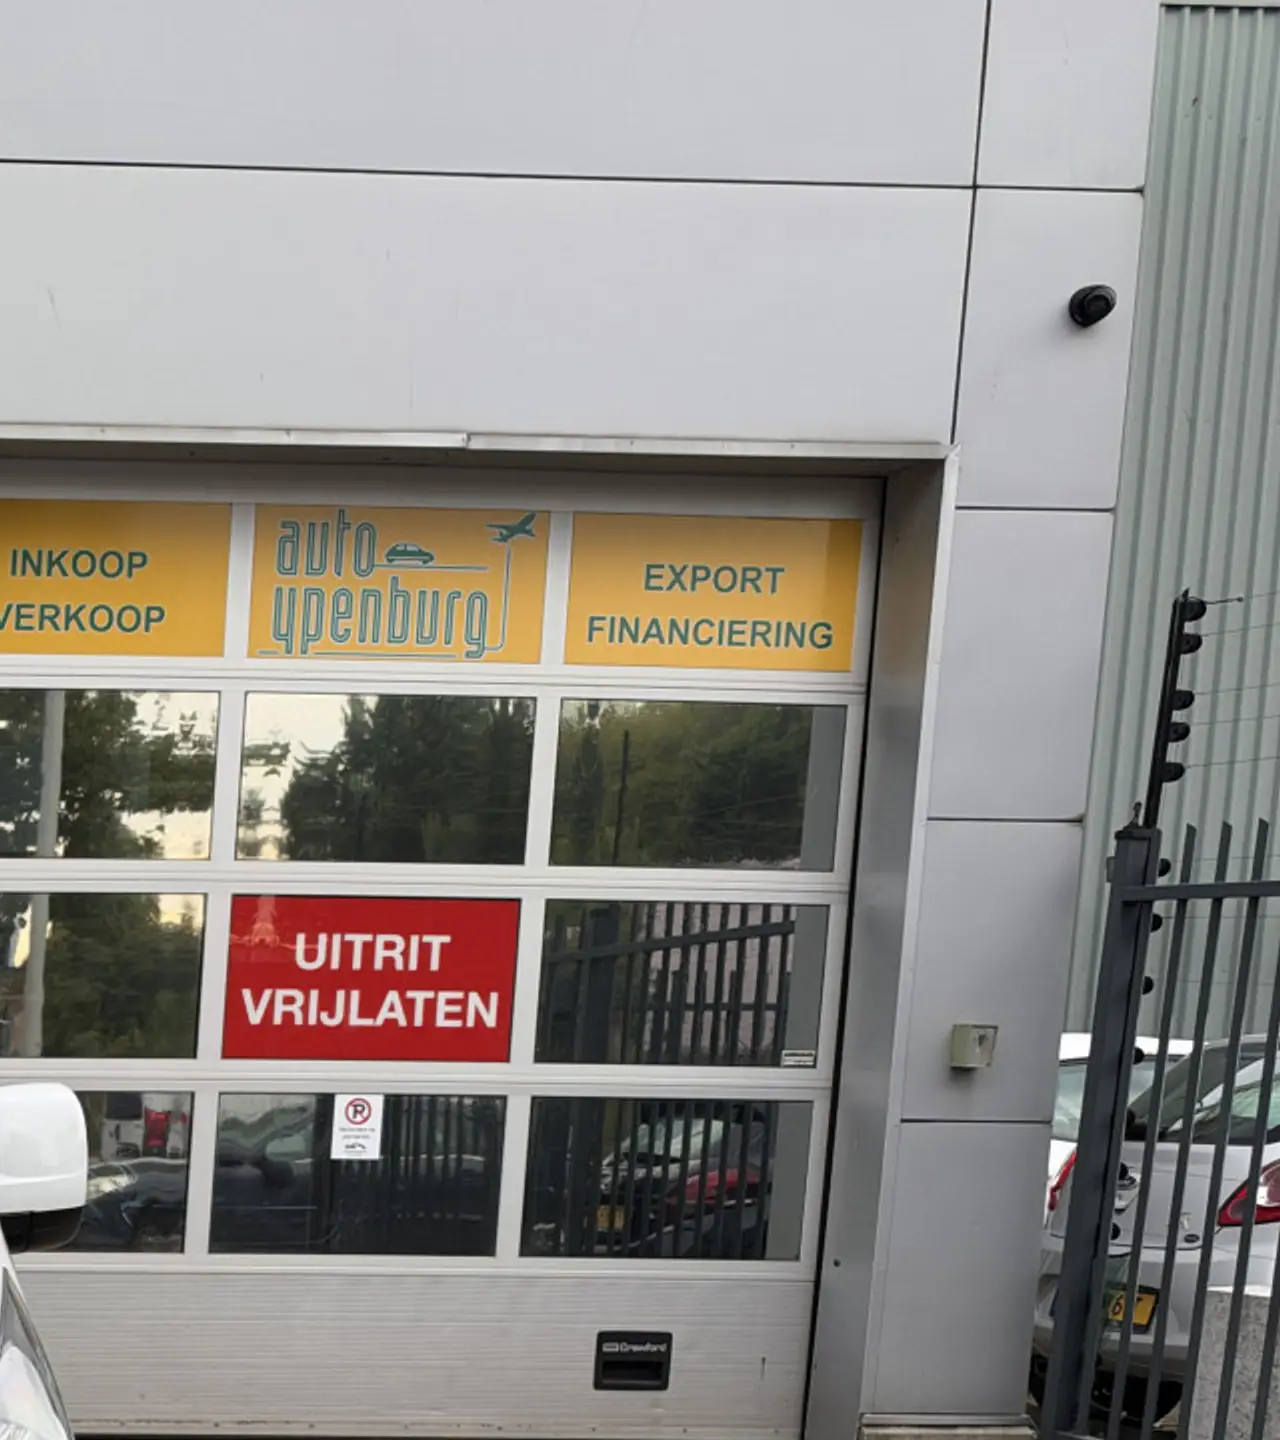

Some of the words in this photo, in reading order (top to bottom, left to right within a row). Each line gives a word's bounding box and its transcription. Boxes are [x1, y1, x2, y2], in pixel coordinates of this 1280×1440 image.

[275, 508, 378, 578] auto
[9, 547, 149, 580] INKOOP
[643, 563, 786, 595] EXPORT
[586, 615, 835, 650] FINANCIERING
[294, 931, 452, 972] UITRIT
[241, 987, 500, 1029] VRIJLATEN
